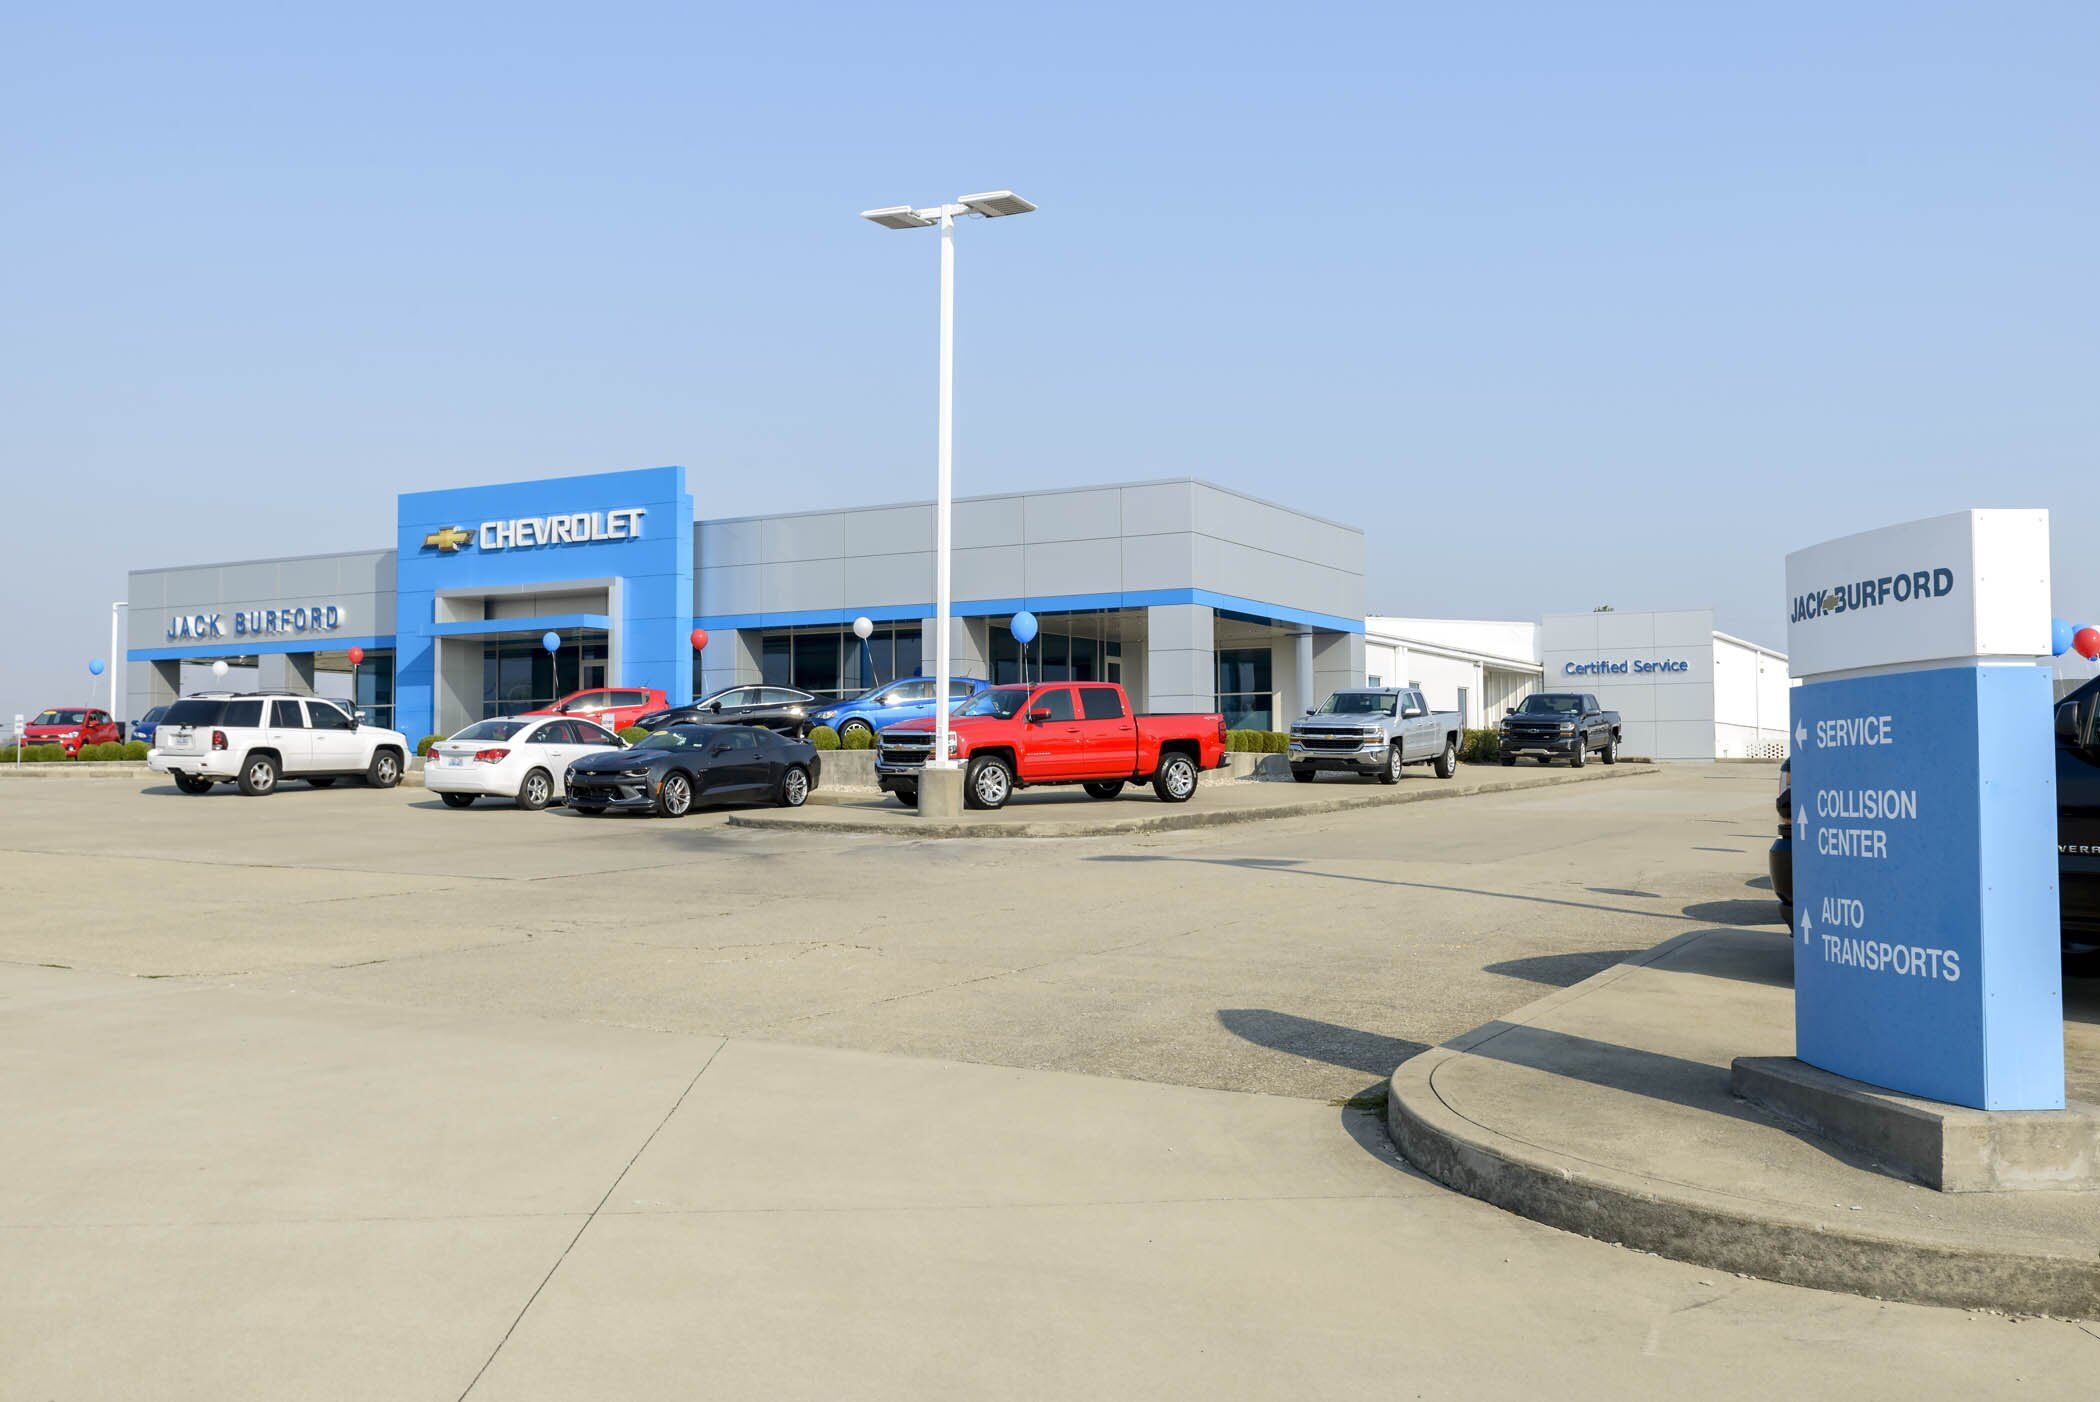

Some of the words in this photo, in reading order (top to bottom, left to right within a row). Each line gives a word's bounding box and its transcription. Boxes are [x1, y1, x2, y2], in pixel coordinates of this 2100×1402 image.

[479, 508, 647, 550] CHEVROLET
[1791, 589, 1828, 624] JACK
[1834, 567, 1954, 613] BURFORD
[167, 613, 222, 640] JACK
[235, 606, 339, 635] BURFORD
[1565, 660, 1628, 674] Certified
[1633, 659, 1688, 673] Service
[1816, 715, 1893, 748] SERVICE
[1817, 789, 1917, 819] COLLISION
[1818, 827, 1887, 859] CENTER
[1821, 897, 1864, 928] AUTO
[1821, 934, 1961, 982] TRANSPORTS
